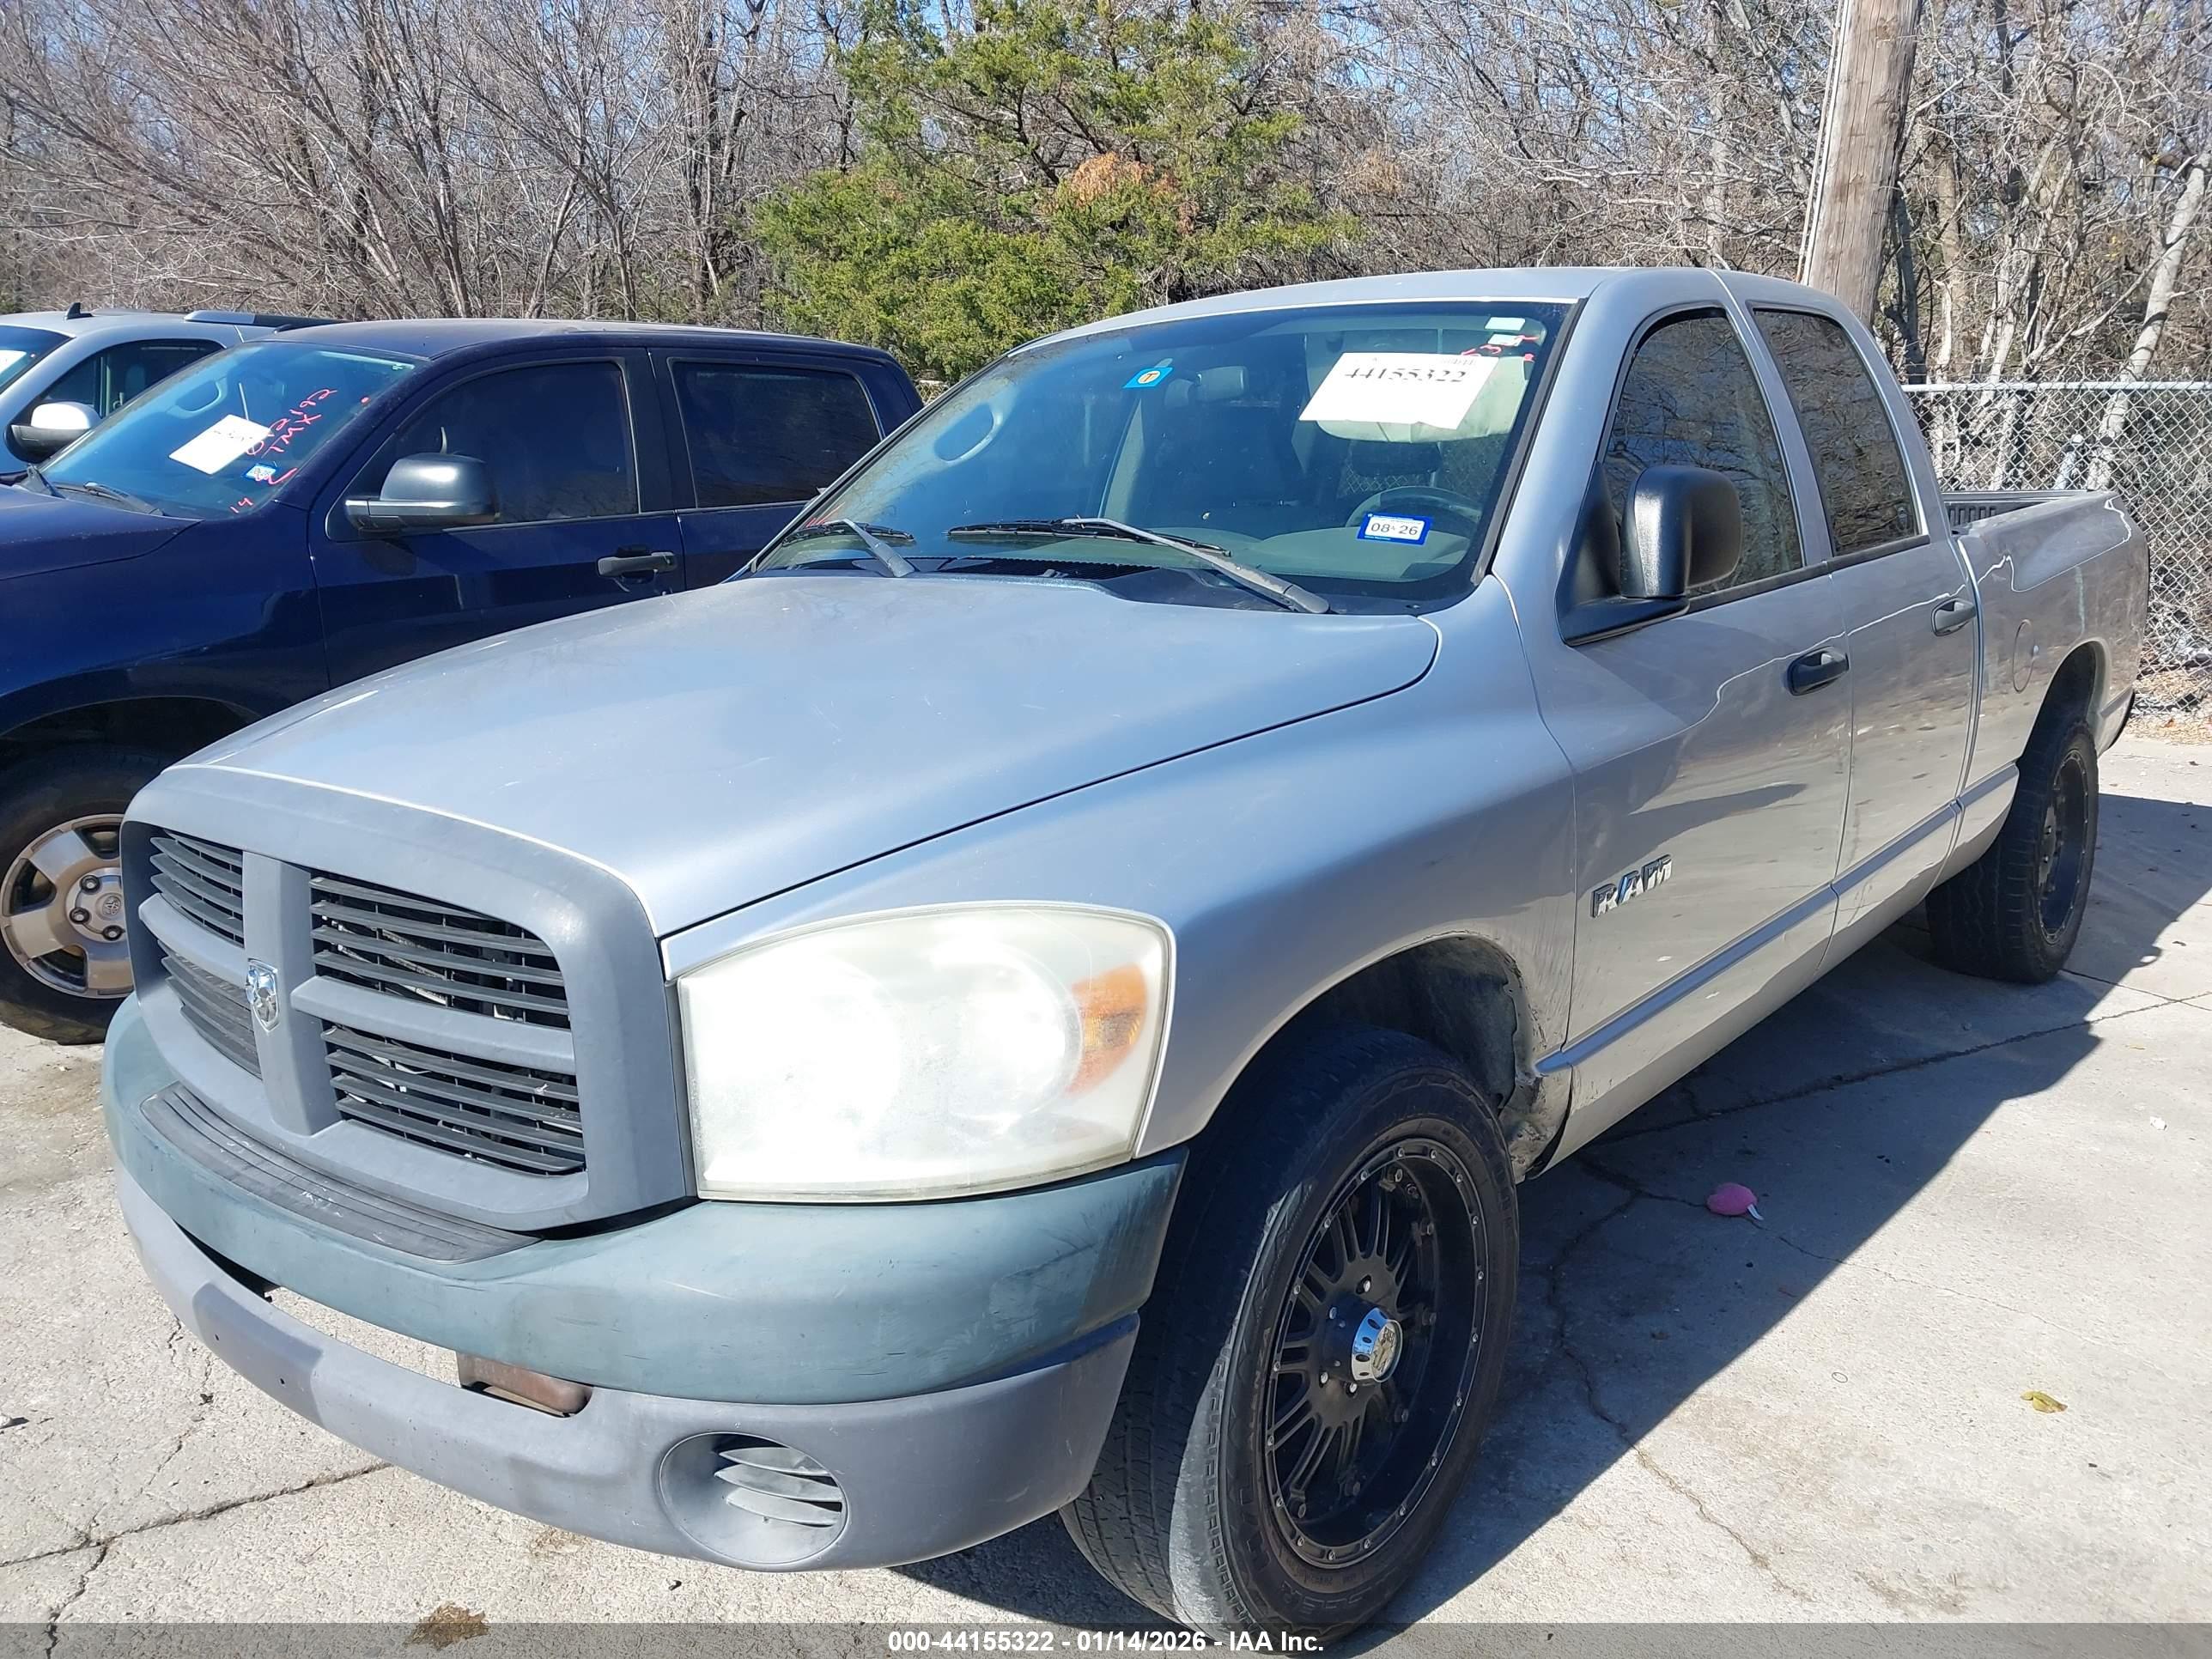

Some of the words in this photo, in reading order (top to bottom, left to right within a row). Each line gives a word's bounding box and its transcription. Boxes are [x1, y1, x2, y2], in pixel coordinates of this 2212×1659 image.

[1344, 368, 1468, 383] 44155322
[1370, 522, 1390, 533] 08
[1398, 525, 1419, 536] 26
[1590, 854, 1672, 918] RAM
